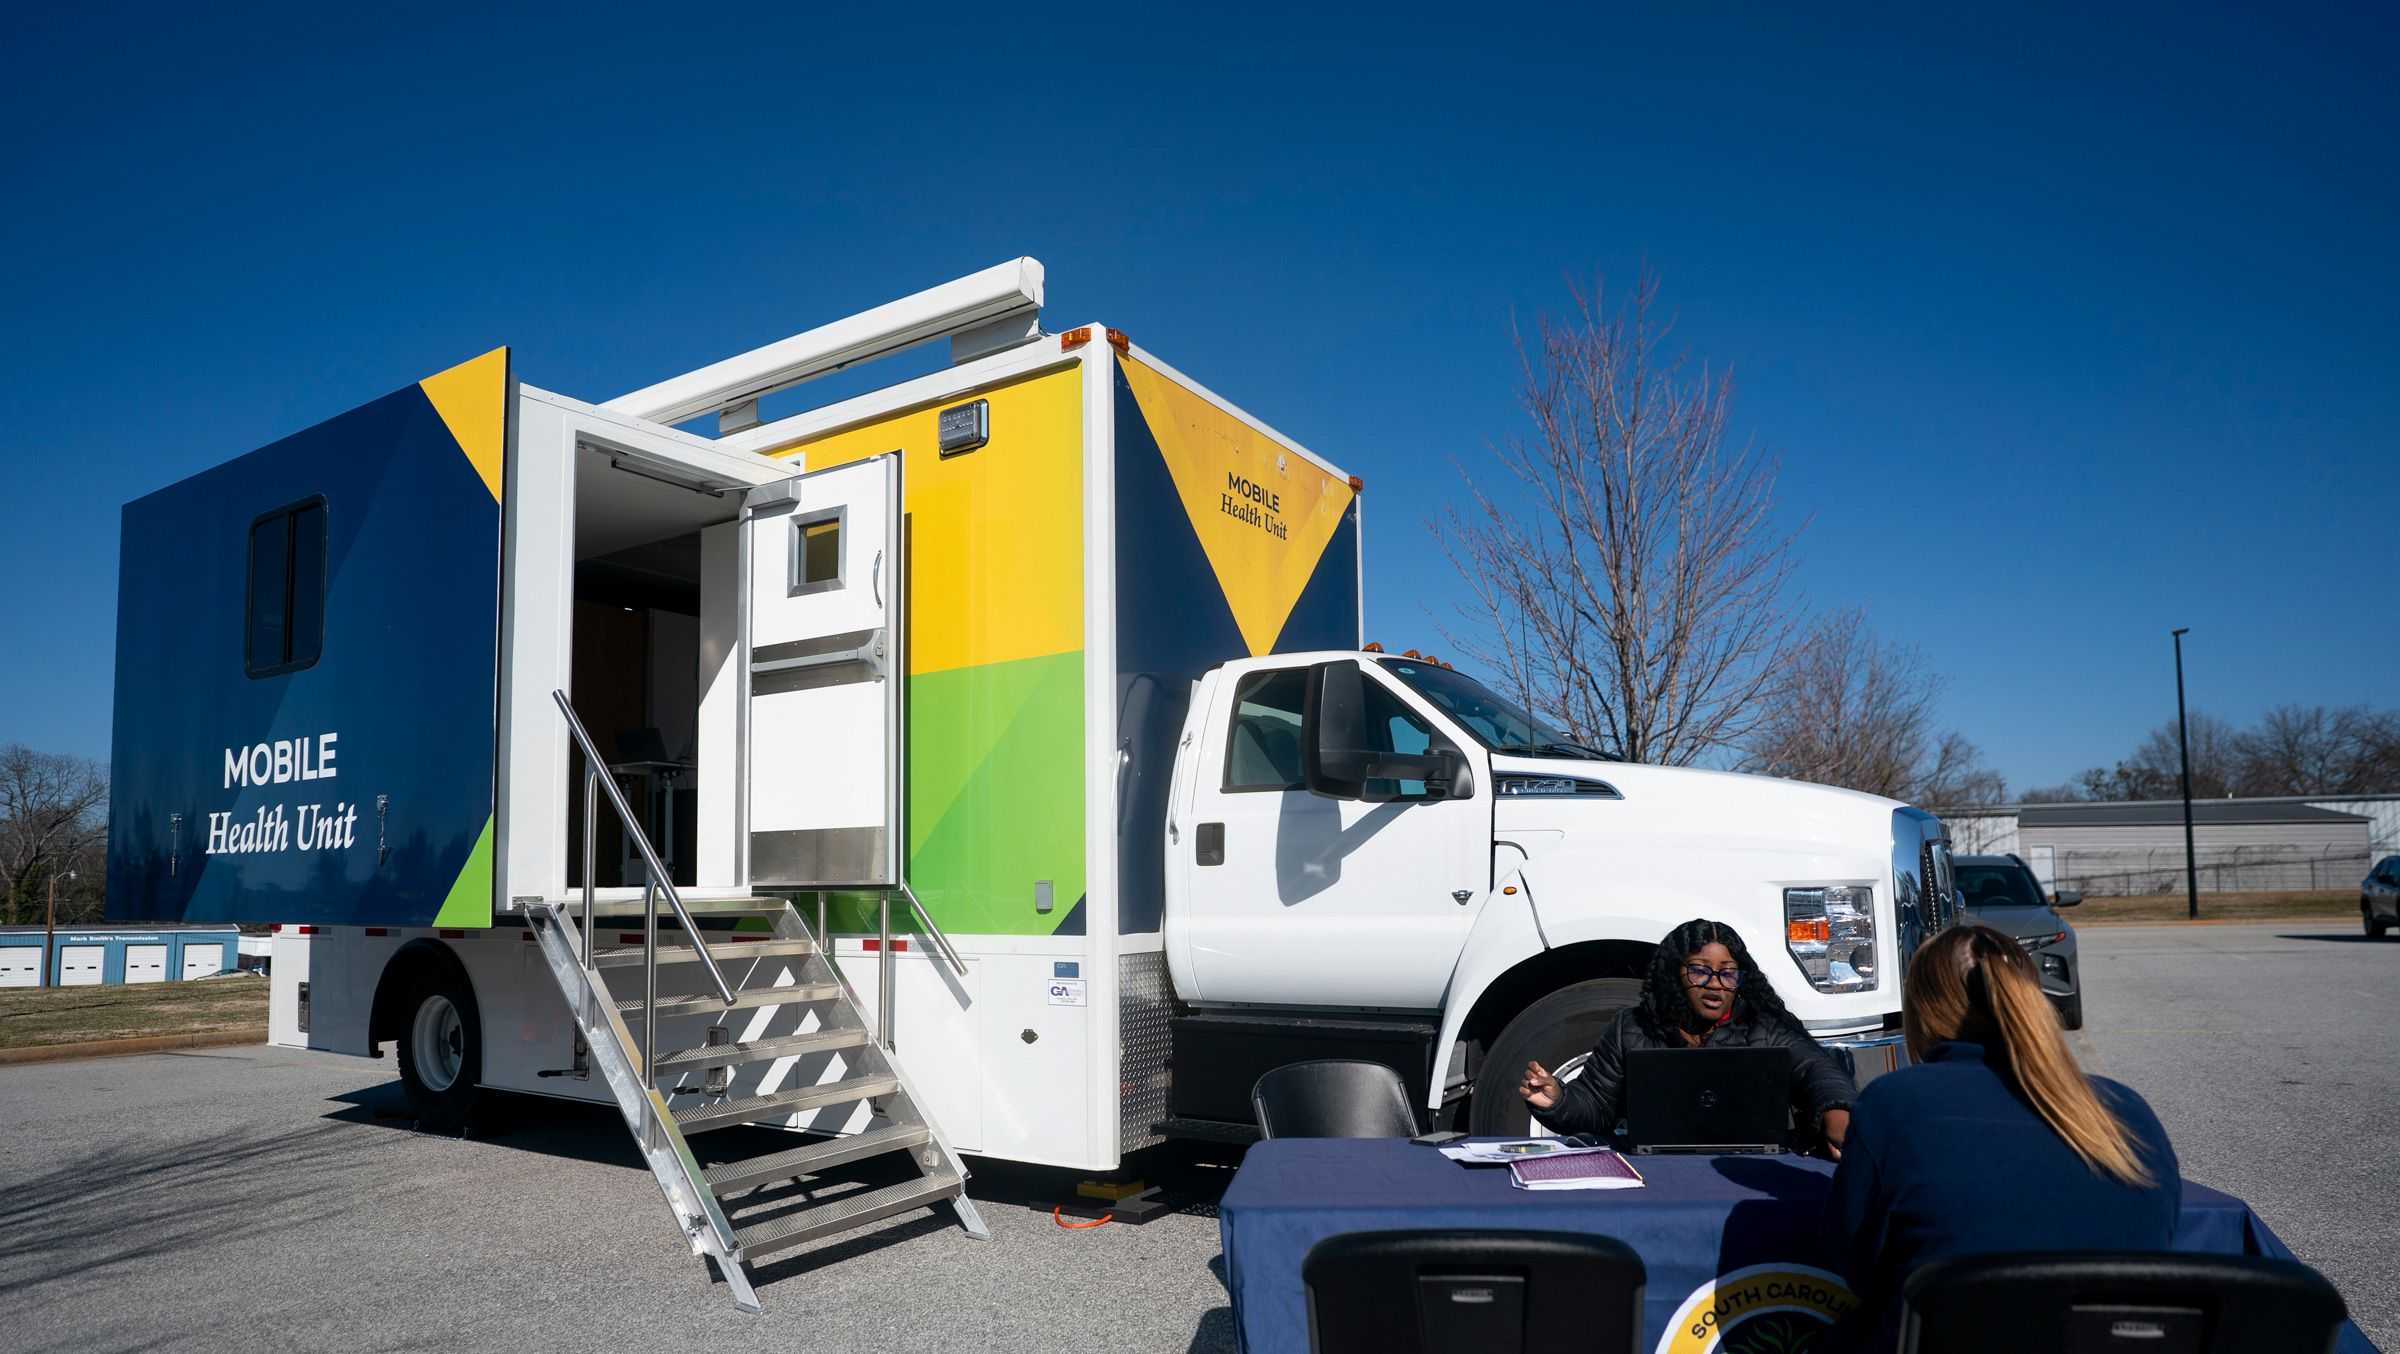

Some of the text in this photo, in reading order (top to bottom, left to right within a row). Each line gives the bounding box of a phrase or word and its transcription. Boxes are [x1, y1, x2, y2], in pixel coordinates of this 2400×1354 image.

[1220, 493, 1288, 541] Health Unit
[1228, 471, 1280, 513] MOBILE
[224, 732, 338, 789] MOBILE
[205, 801, 358, 854] Health Unit
[1691, 1282, 1850, 1340] SOUTH CAROLI
